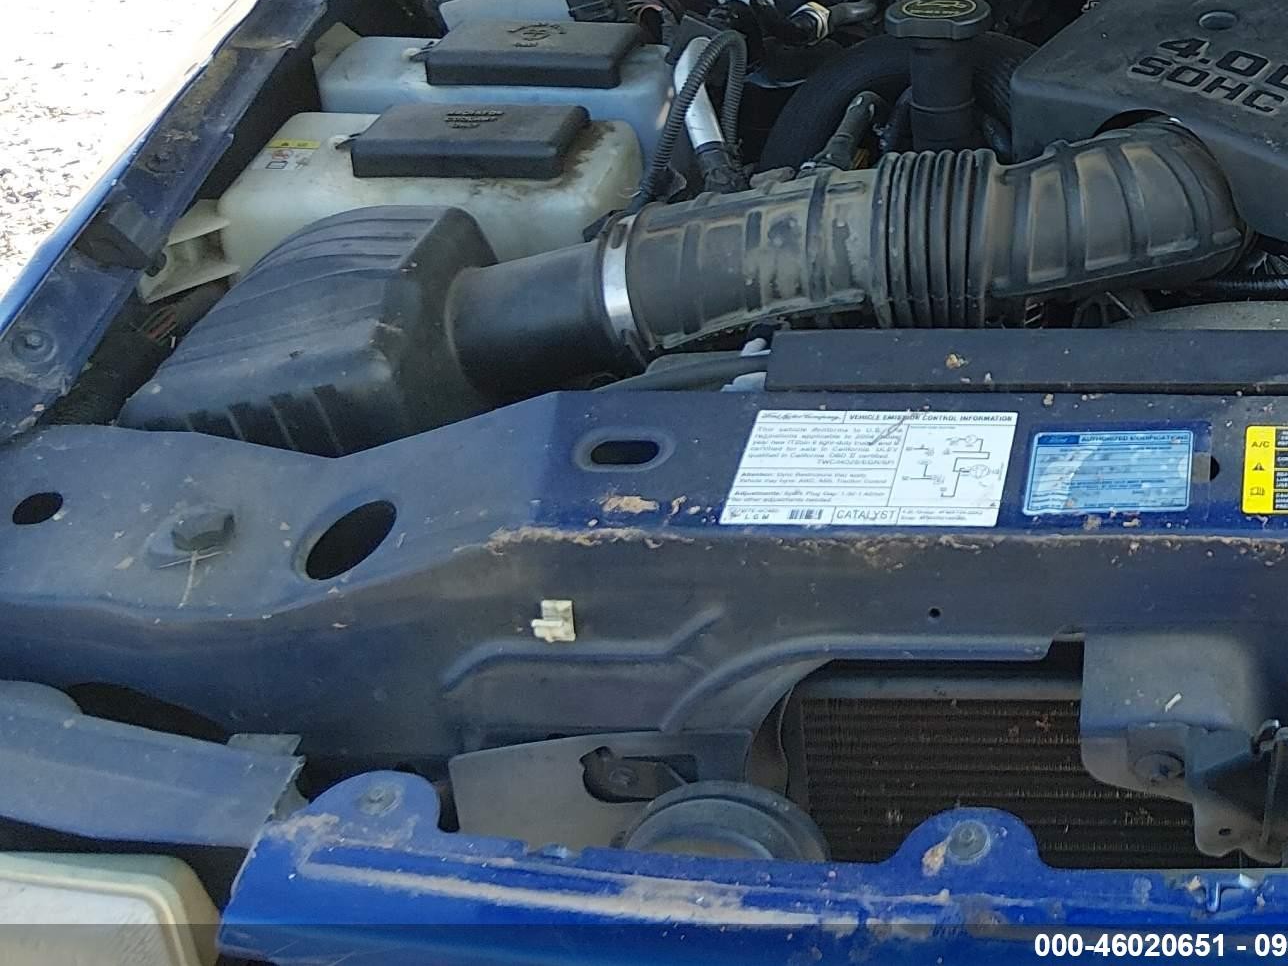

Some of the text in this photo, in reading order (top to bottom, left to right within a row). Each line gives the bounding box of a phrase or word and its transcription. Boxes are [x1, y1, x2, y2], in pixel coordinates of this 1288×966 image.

[1131, 56, 1285, 113] SOHC
[1251, 441, 1270, 449] A/C
[836, 510, 895, 521] CATALYST
